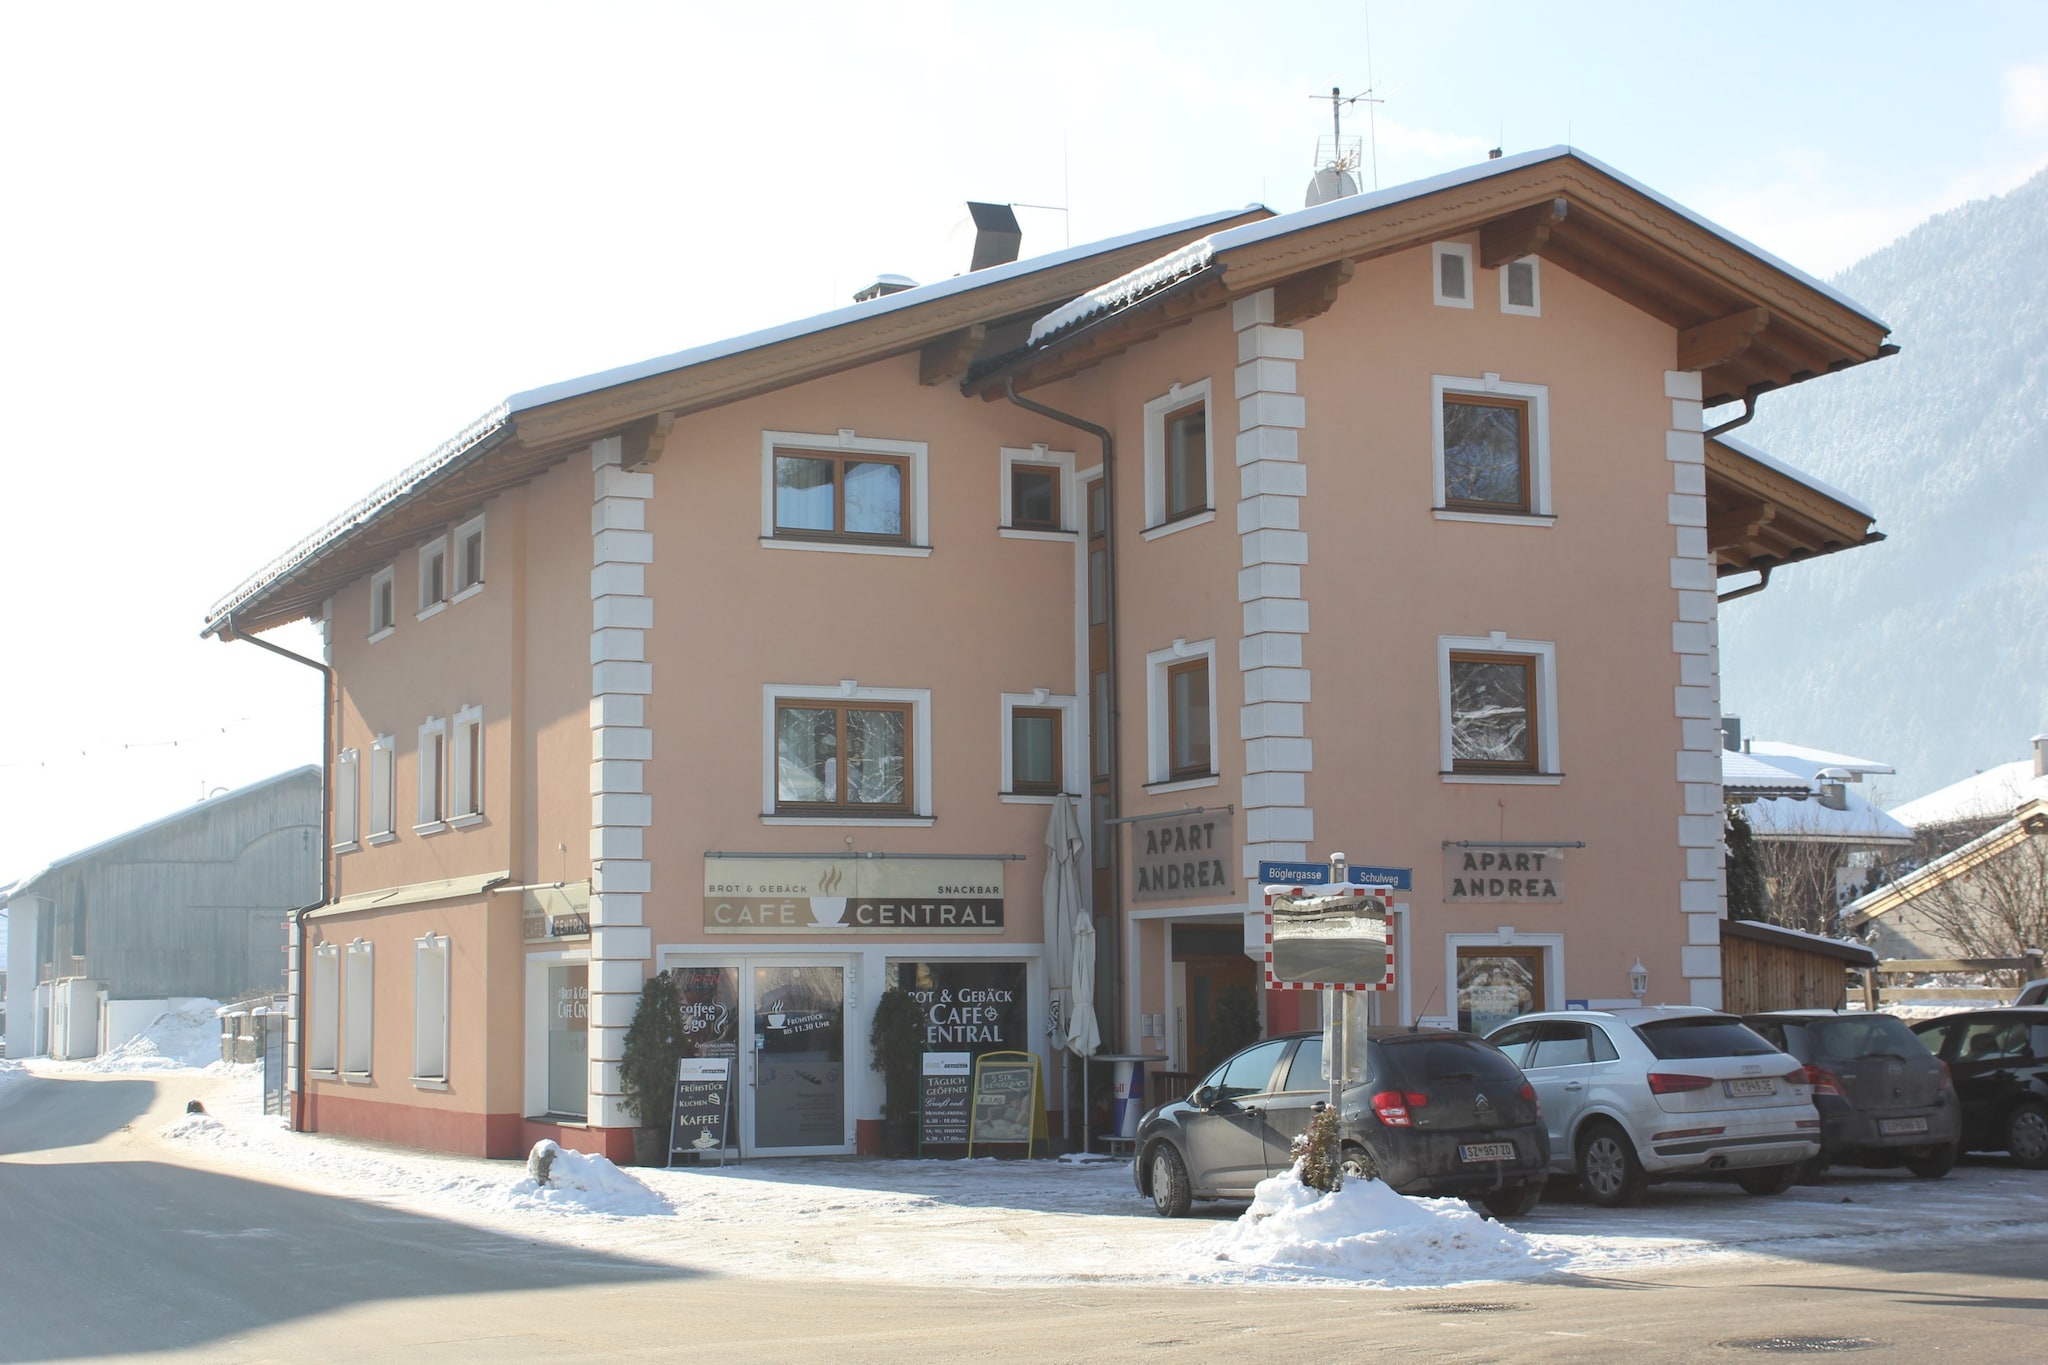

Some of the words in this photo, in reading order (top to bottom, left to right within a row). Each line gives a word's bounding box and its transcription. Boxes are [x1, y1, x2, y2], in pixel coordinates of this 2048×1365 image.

[1146, 822, 1214, 855] APART
[1463, 852, 1545, 871] APART
[1138, 859, 1225, 892] ANDREA
[1269, 868, 1322, 881] Böglergasse
[1360, 872, 1399, 886] Schulweg
[709, 885, 741, 893] BROT
[746, 885, 753, 893] &
[759, 883, 807, 893] GEBÄCK
[938, 886, 1000, 894] SNACKBAR
[1452, 878, 1557, 897] ANDREA
[714, 900, 796, 924] CAFÉ
[856, 904, 996, 925] CENTRAL
[940, 988, 952, 1003] &
[958, 988, 1013, 1003] GEBÄCK
[680, 1003, 715, 1017] coffee
[929, 1003, 982, 1025] CAFÉ
[705, 1013, 715, 1021] to
[691, 1020, 707, 1032] go
[794, 1024, 814, 1033] 11.30
[815, 1020, 830, 1029] UHR
[927, 1025, 1004, 1044] ENTRAL
[680, 1083, 724, 1093] FRÜHSTÜCK
[927, 1077, 966, 1086] TÄGLICH
[926, 1086, 969, 1096] GEÖFFNET
[679, 1100, 708, 1108] KUCHEN
[680, 1115, 720, 1126] KAFFEE
[1467, 1146, 1479, 1157] SZ
[1483, 1145, 1498, 1156] 957
